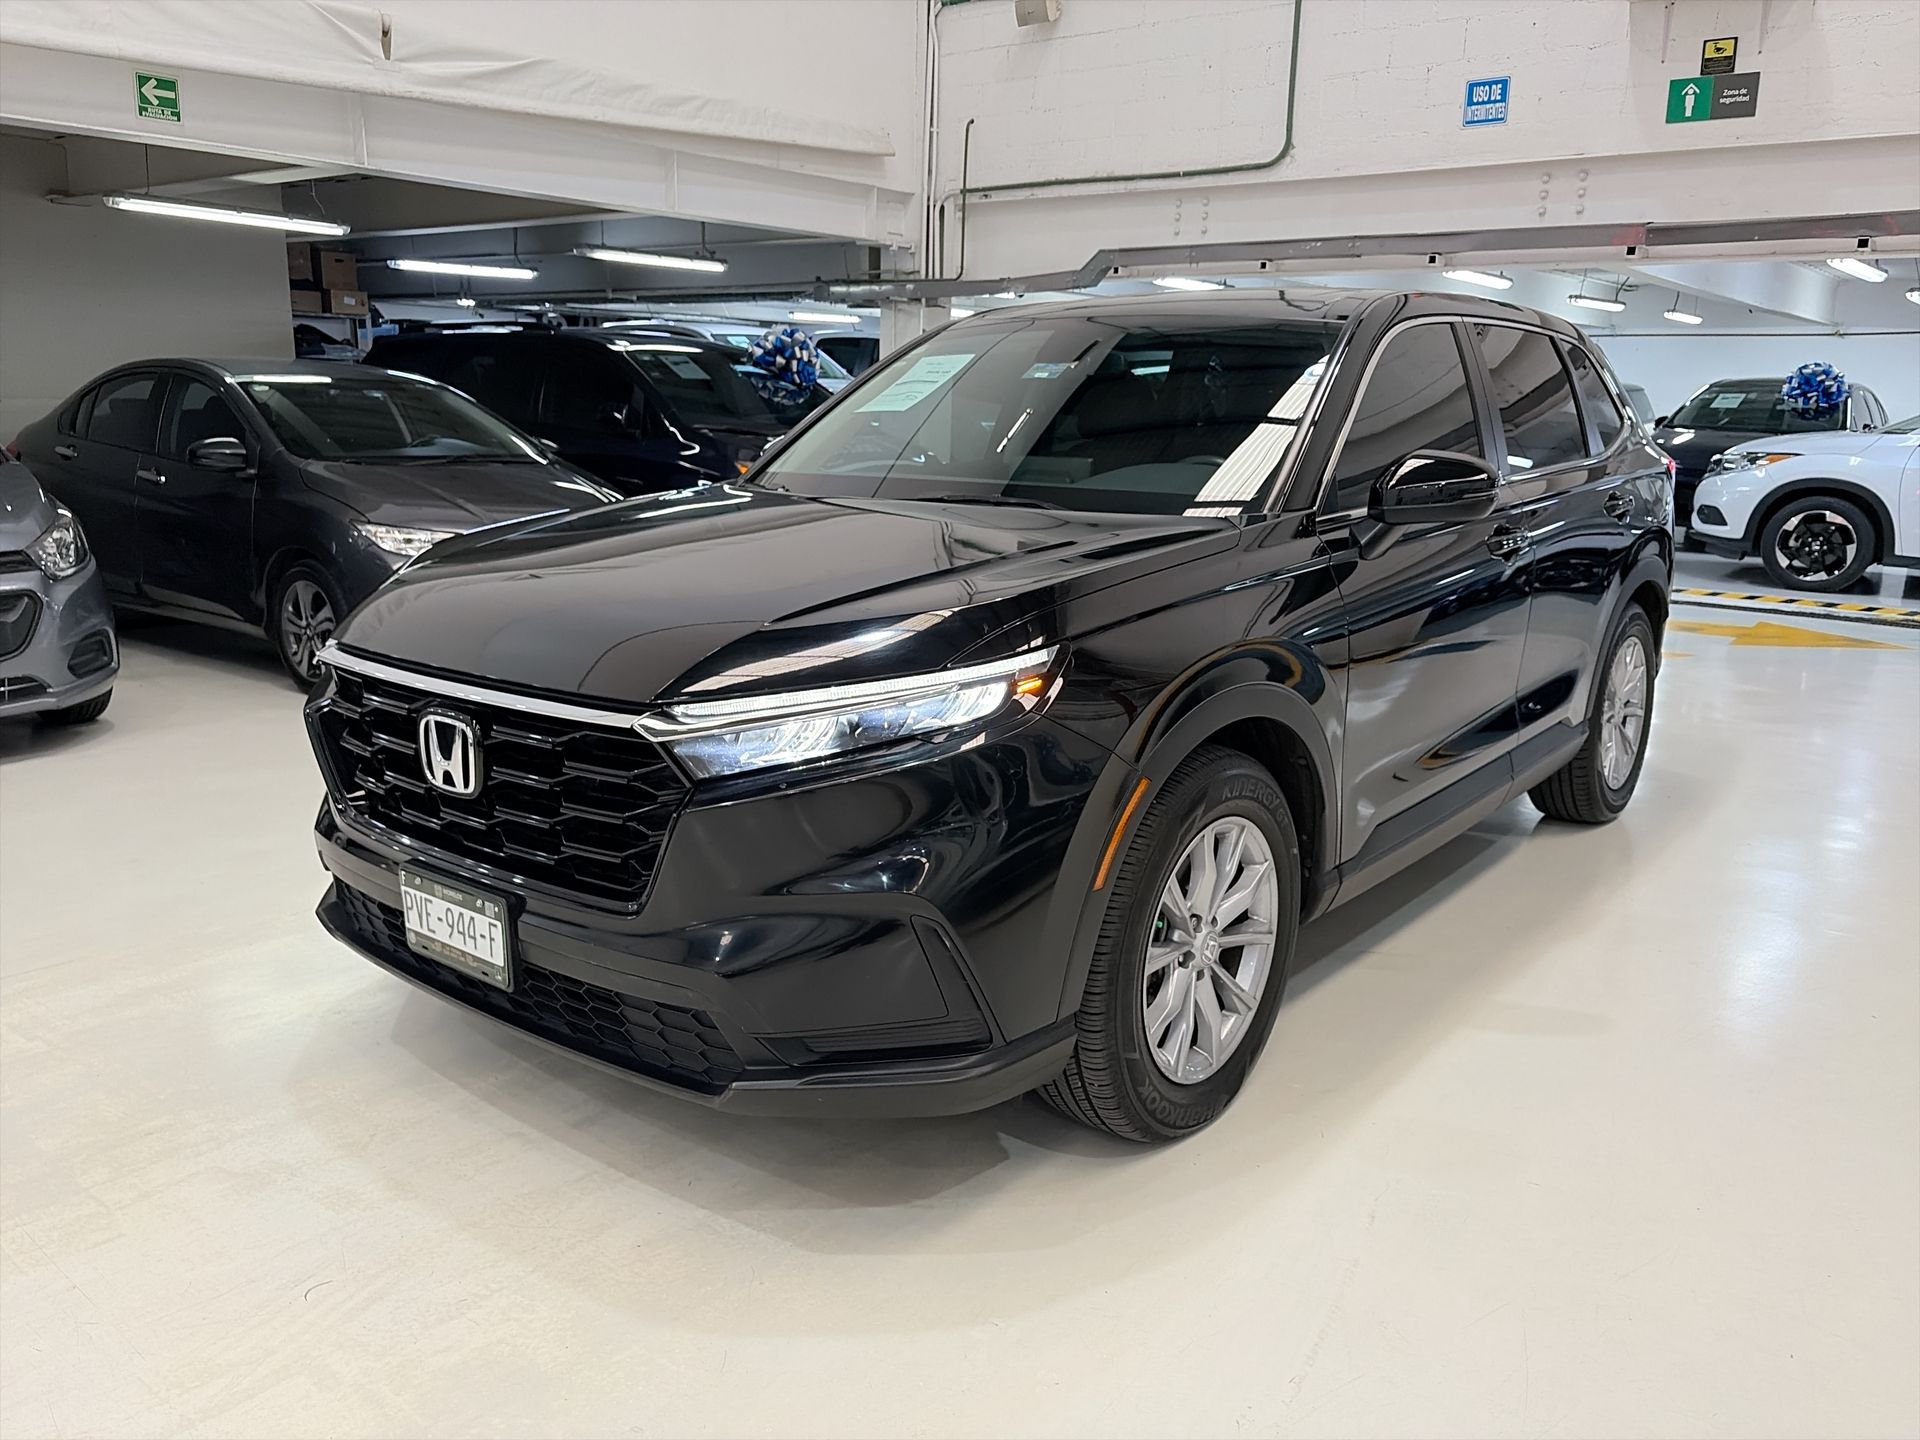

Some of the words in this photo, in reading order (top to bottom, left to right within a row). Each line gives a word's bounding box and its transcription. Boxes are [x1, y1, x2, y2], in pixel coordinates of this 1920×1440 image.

[1472, 85, 1490, 103] USO
[1490, 84, 1503, 101] DE
[1722, 88, 1739, 96] Zona
[1739, 87, 1748, 95] de
[1719, 95, 1750, 105] seguridad
[403, 889, 498, 959] PVE-944-F
